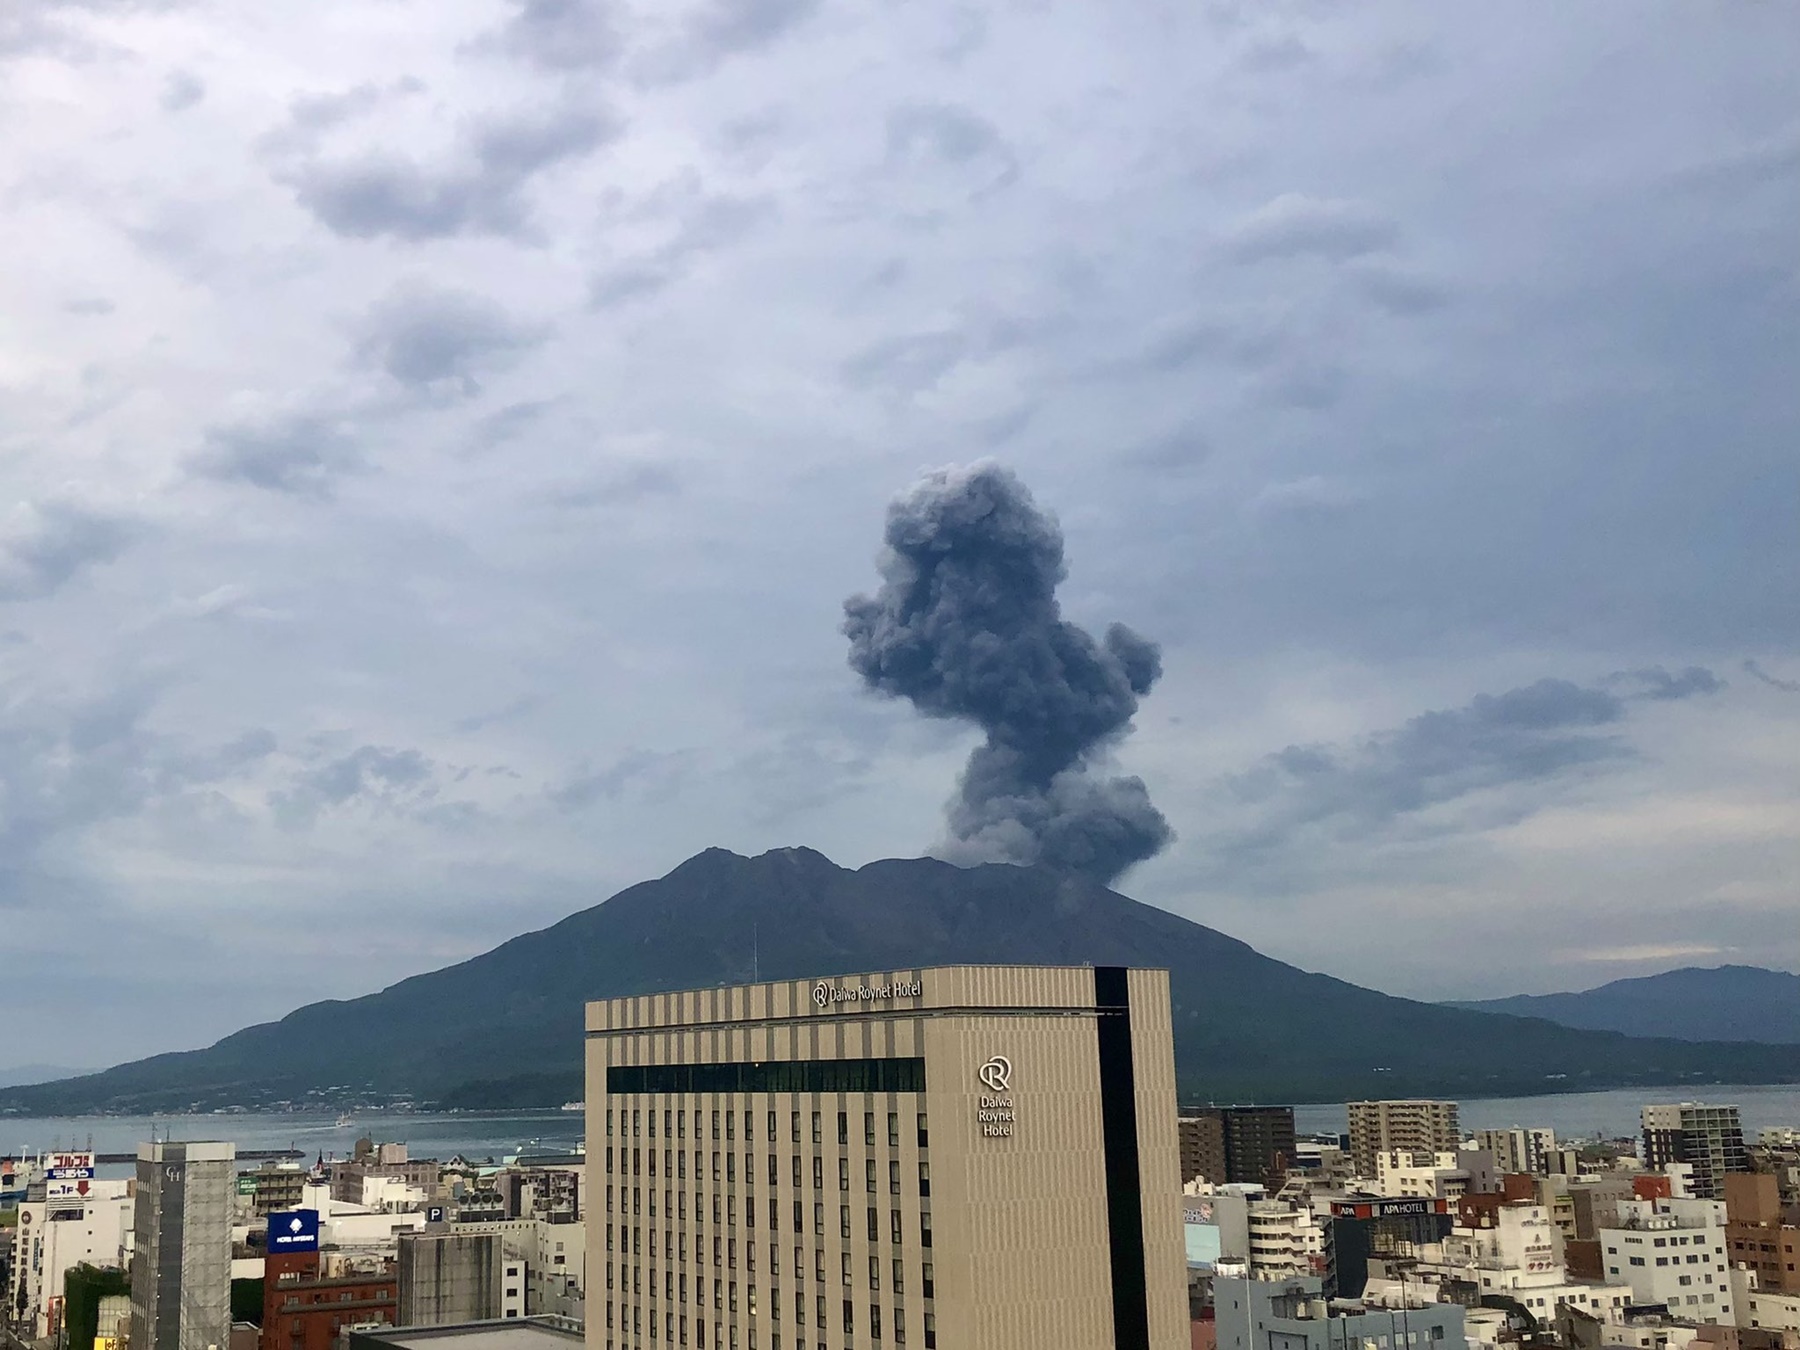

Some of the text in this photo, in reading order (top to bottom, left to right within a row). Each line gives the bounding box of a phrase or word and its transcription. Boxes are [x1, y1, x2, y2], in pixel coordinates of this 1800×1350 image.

[829, 986, 857, 1002] Daiwa
[858, 984, 892, 1003] Roynet
[894, 980, 921, 997] Hotel
[981, 1096, 1013, 1108] Daiwa
[979, 1110, 1016, 1124] Roynet
[984, 1124, 1013, 1136] Hotel
[431, 1208, 441, 1221] P
[1340, 1206, 1356, 1216] APA
[1383, 1203, 1424, 1214] APA HOTEL
